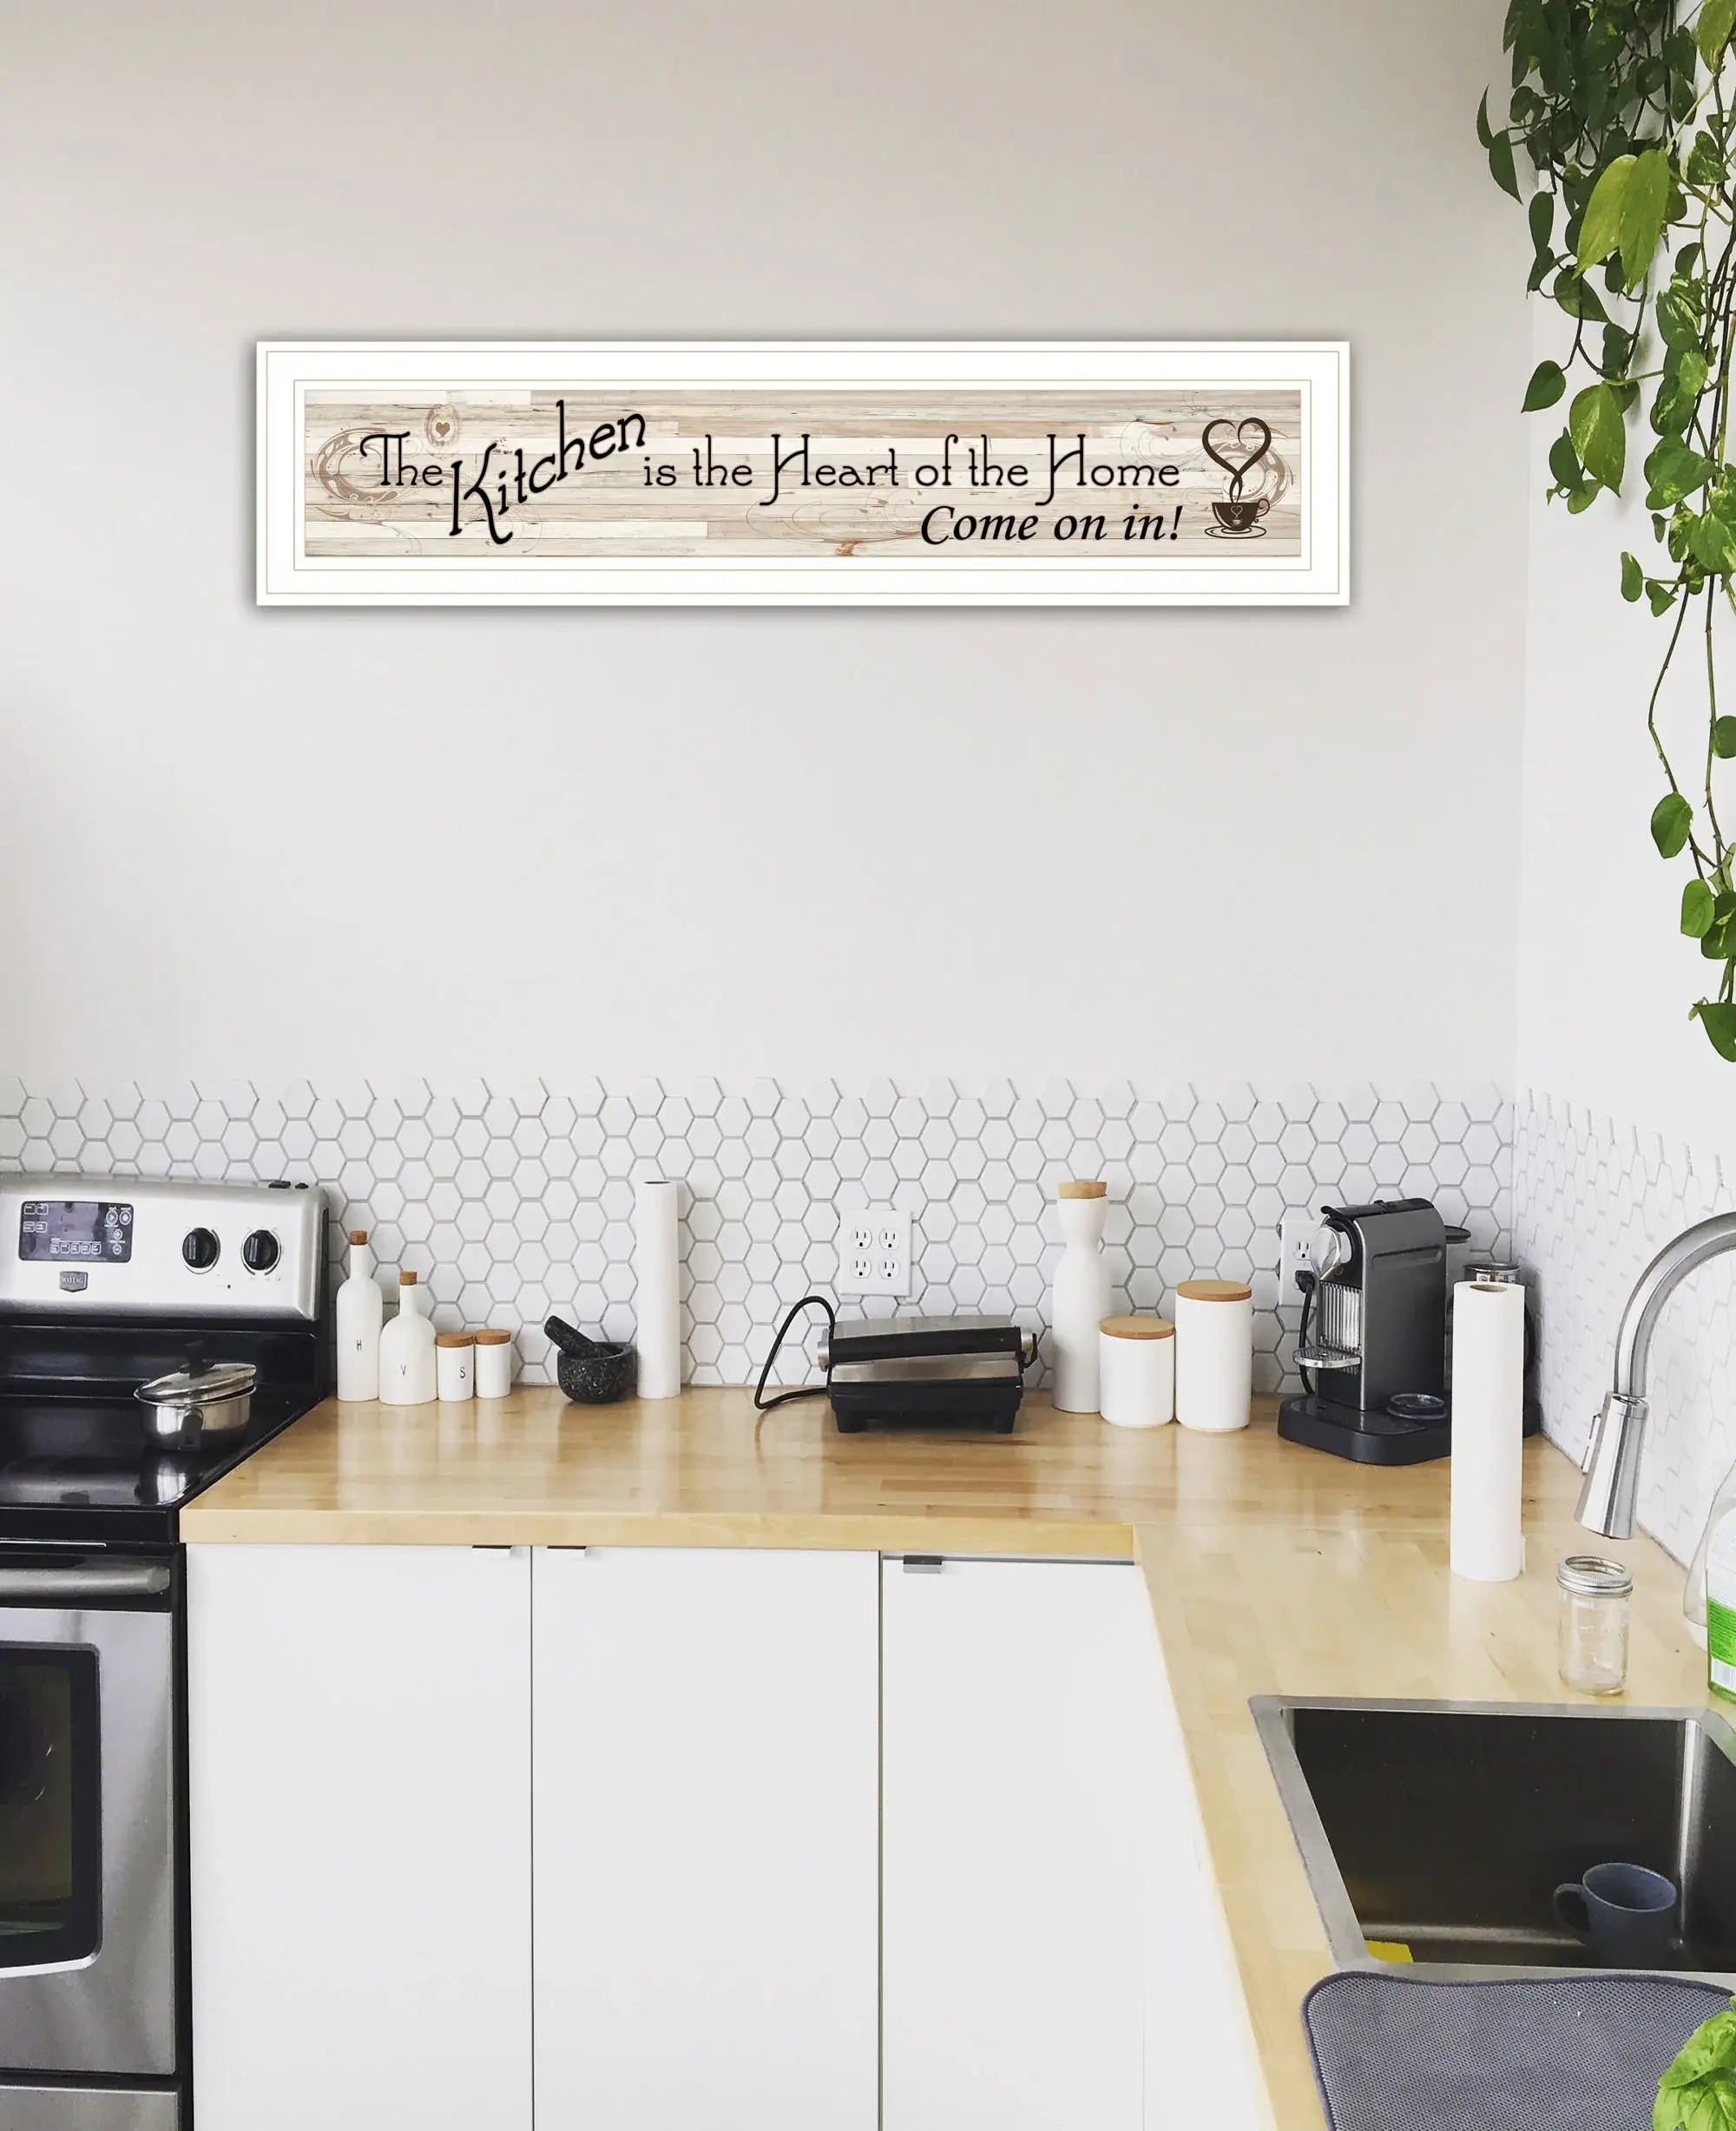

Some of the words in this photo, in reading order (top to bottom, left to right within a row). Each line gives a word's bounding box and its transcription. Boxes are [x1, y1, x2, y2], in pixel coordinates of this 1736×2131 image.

[360, 432, 443, 486] The
[449, 399, 646, 545] Kitchen
[644, 435, 678, 486] is
[694, 433, 753, 486] the
[760, 433, 899, 506] Heart
[916, 433, 959, 486] of
[968, 434, 1029, 486] the
[1036, 433, 1180, 506] Home
[921, 505, 1039, 544] Come
[1053, 516, 1108, 541] on
[1122, 505, 1183, 541] in!
[356, 1339, 363, 1352] H
[400, 1365, 407, 1376] V
[459, 1366, 466, 1378] S
